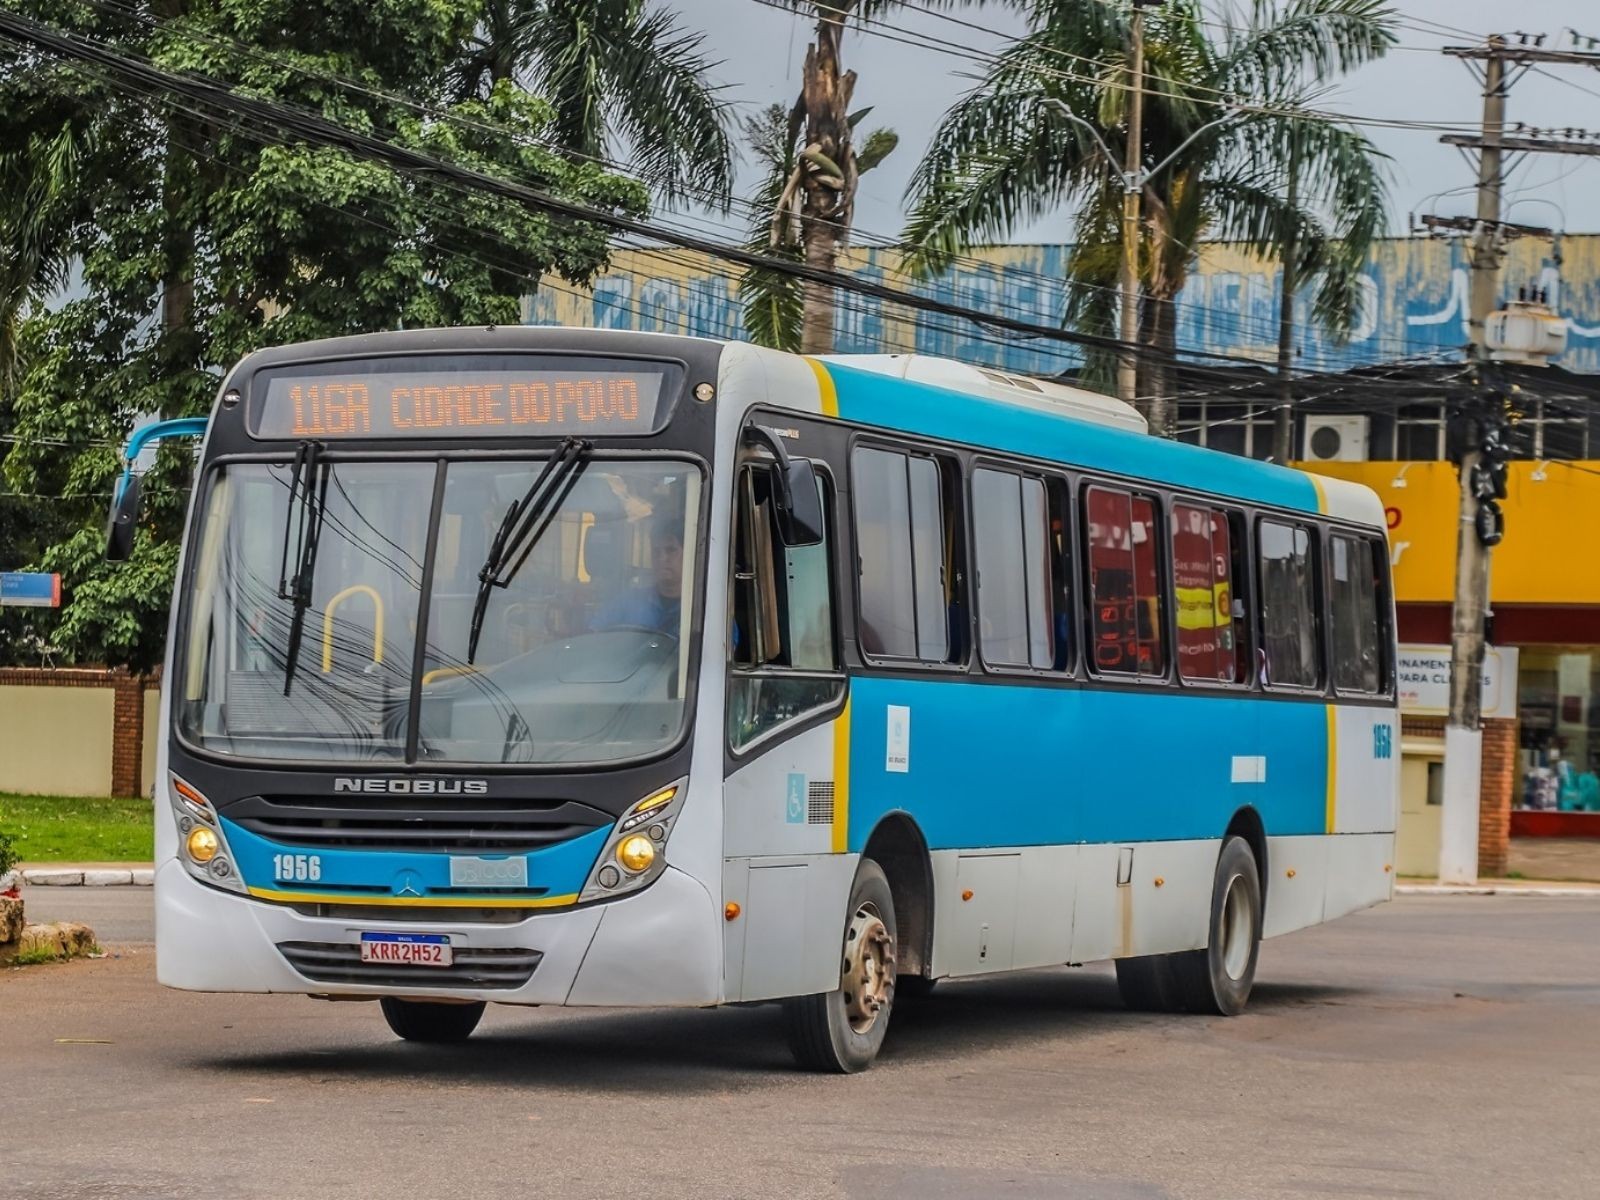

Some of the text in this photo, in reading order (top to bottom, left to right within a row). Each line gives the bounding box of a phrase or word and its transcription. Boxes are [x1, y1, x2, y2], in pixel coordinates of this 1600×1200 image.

[290, 379, 639, 435] 116A CIDADE DO POVO
[334, 778, 489, 794] NEOBUS
[273, 854, 322, 881] 1956
[369, 942, 442, 962] KRR2H52
